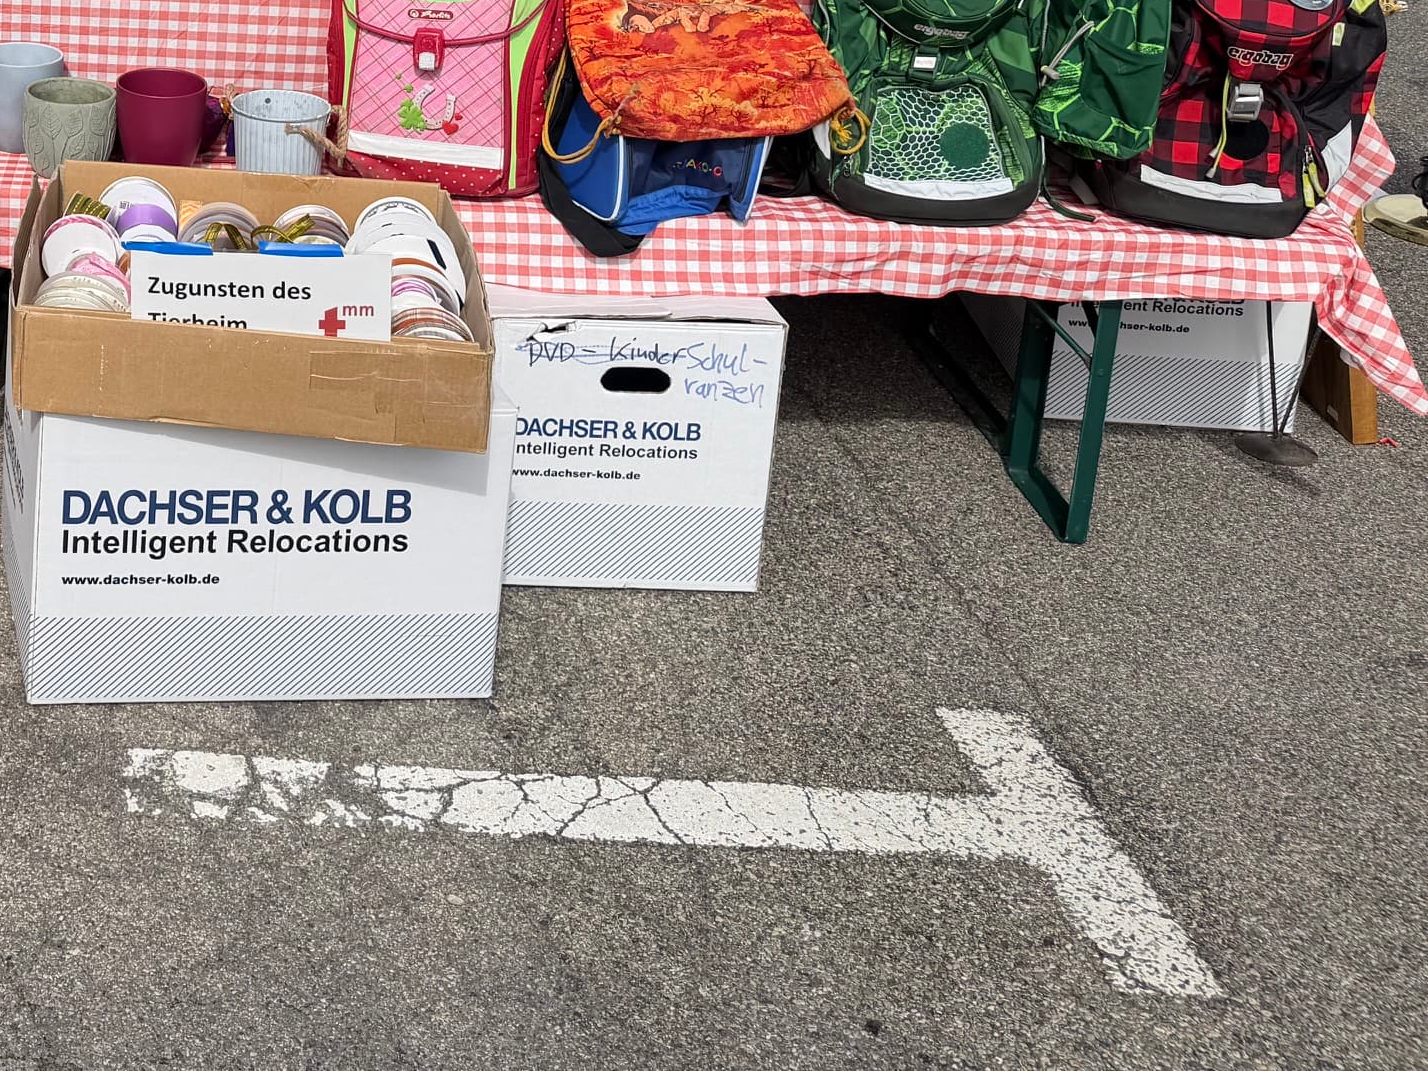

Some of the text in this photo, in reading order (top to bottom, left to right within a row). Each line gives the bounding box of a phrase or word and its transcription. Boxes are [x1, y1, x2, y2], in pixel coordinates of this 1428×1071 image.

[1227, 46, 1293, 70] ergobag
[148, 277, 311, 300] Zugunsten des
[342, 305, 375, 317] mm
[1153, 301, 1244, 317] Relocations
[516, 417, 702, 441] DACHSER & KOLB
[516, 442, 698, 459] ntelligent Relocations
[512, 468, 641, 480] www.dachser-kolb.de
[61, 489, 412, 525] DACHSER & KOLB
[62, 529, 409, 560] Intelligent Relocations
[61, 574, 220, 586] www.dachser-kolb.de
